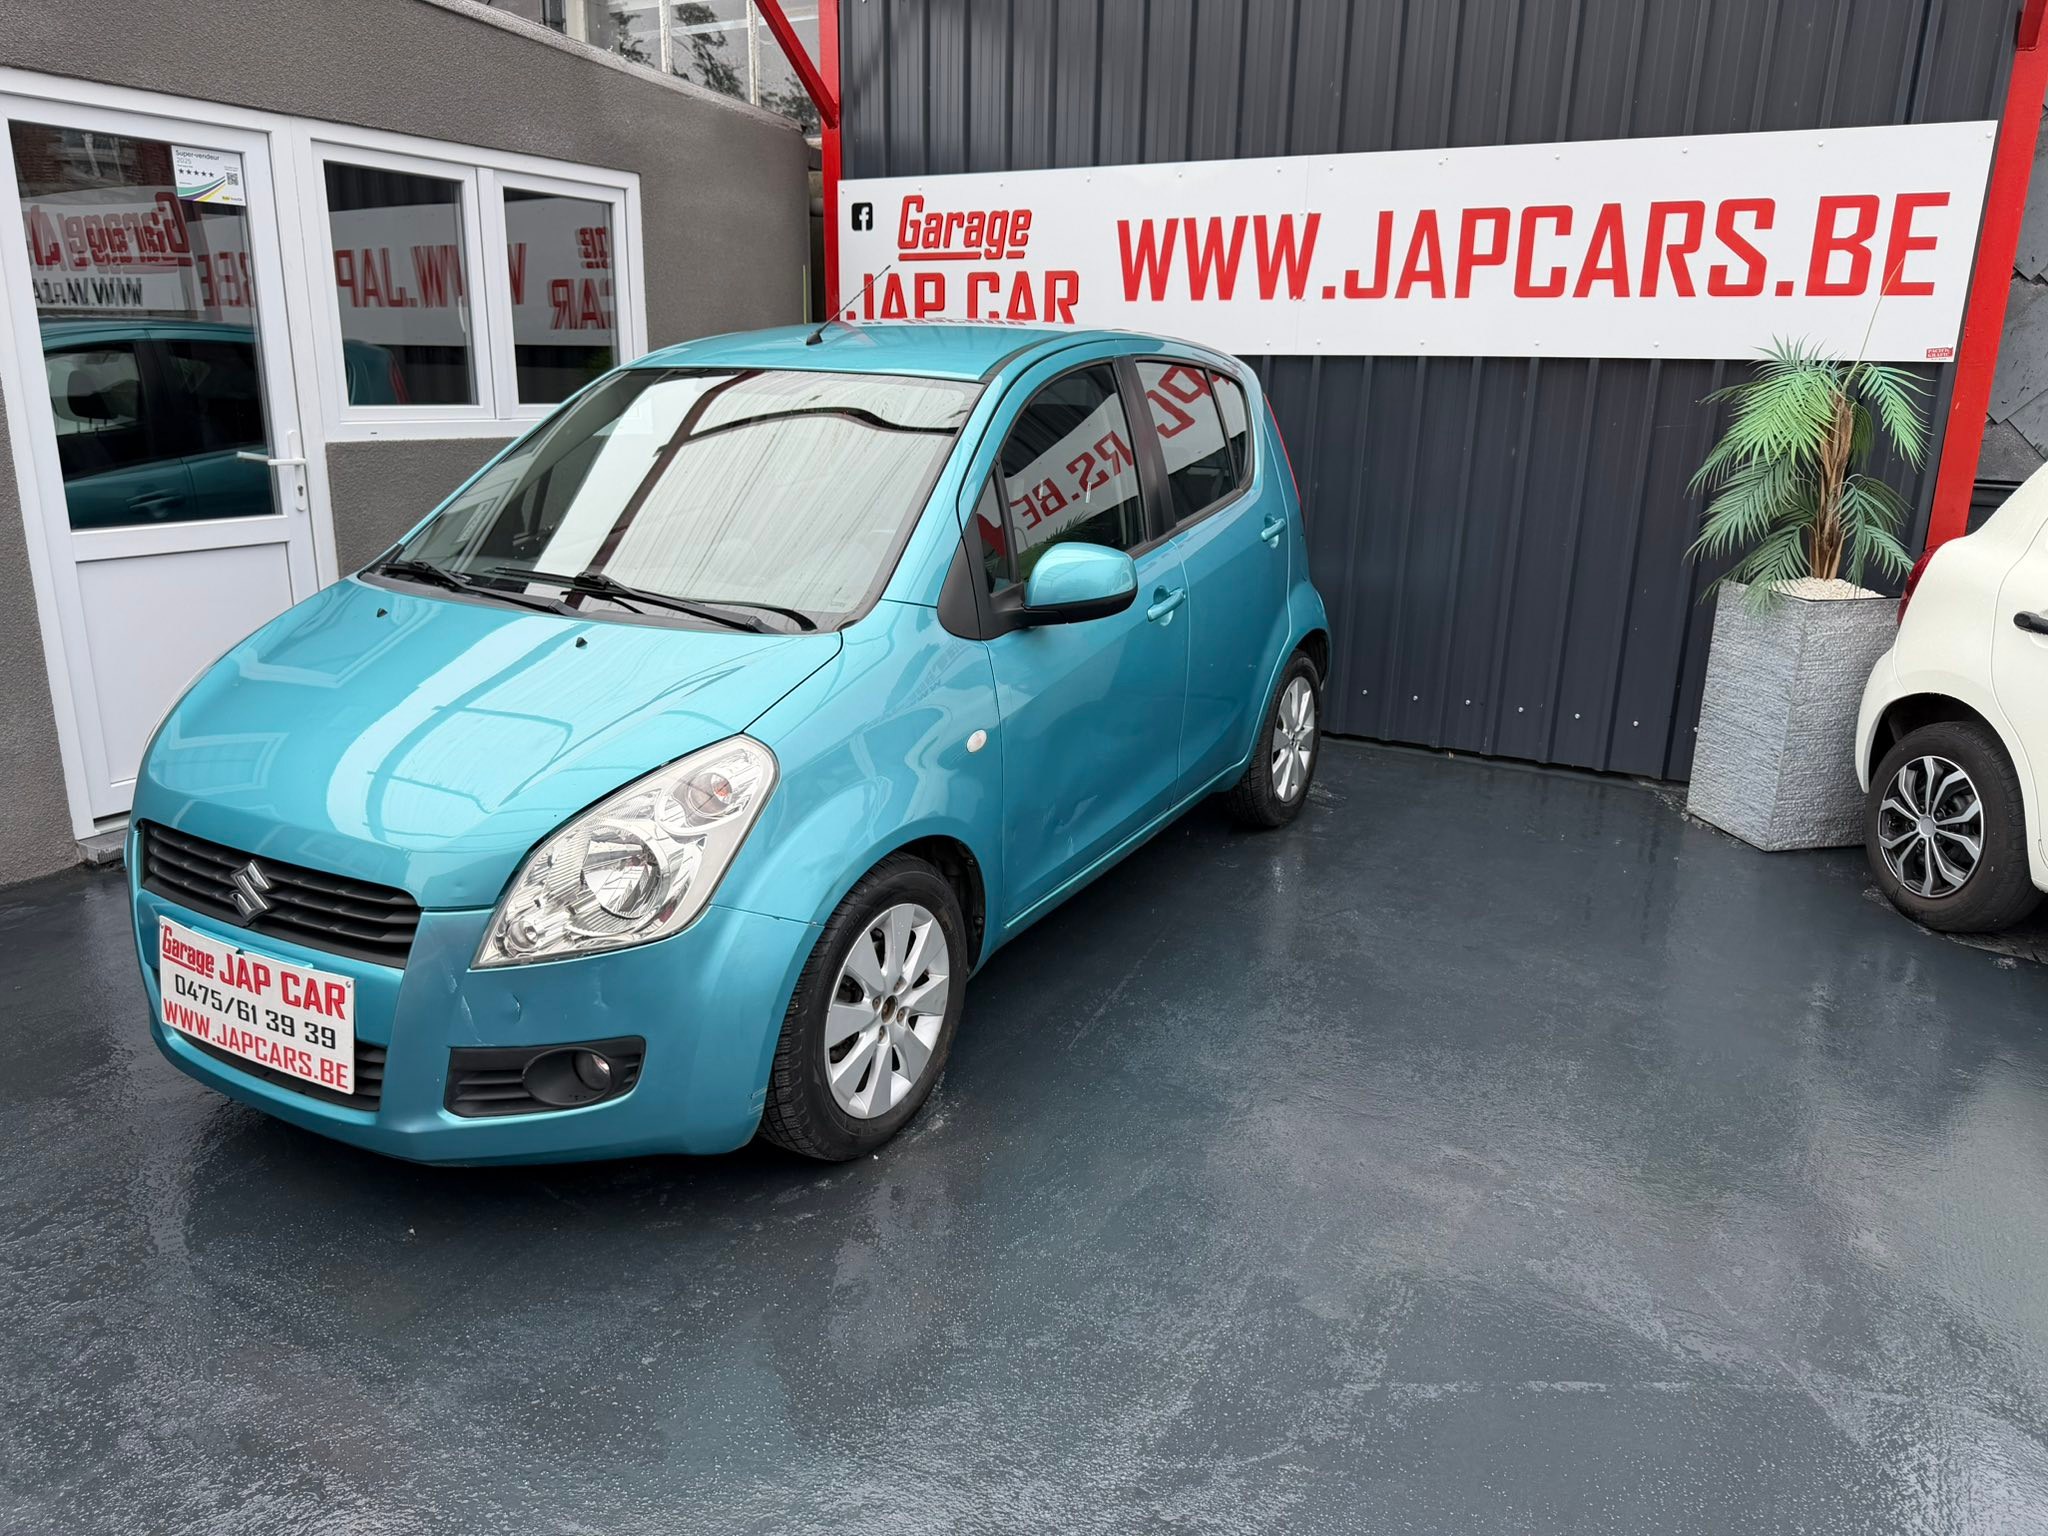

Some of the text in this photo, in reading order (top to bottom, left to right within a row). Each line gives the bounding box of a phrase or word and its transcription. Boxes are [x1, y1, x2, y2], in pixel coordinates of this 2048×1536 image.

[175, 150, 220, 161] Super-vendeur
[897, 194, 1033, 260] Garage
[1116, 192, 1951, 302] WWW.JAPCARS.BE
[846, 270, 1080, 324] JAP CAR
[162, 925, 346, 1020] Garage JAP CAR
[163, 997, 349, 1090] WWW.JAPCARS.BE
[174, 973, 337, 1050] 0475/61 39 39
